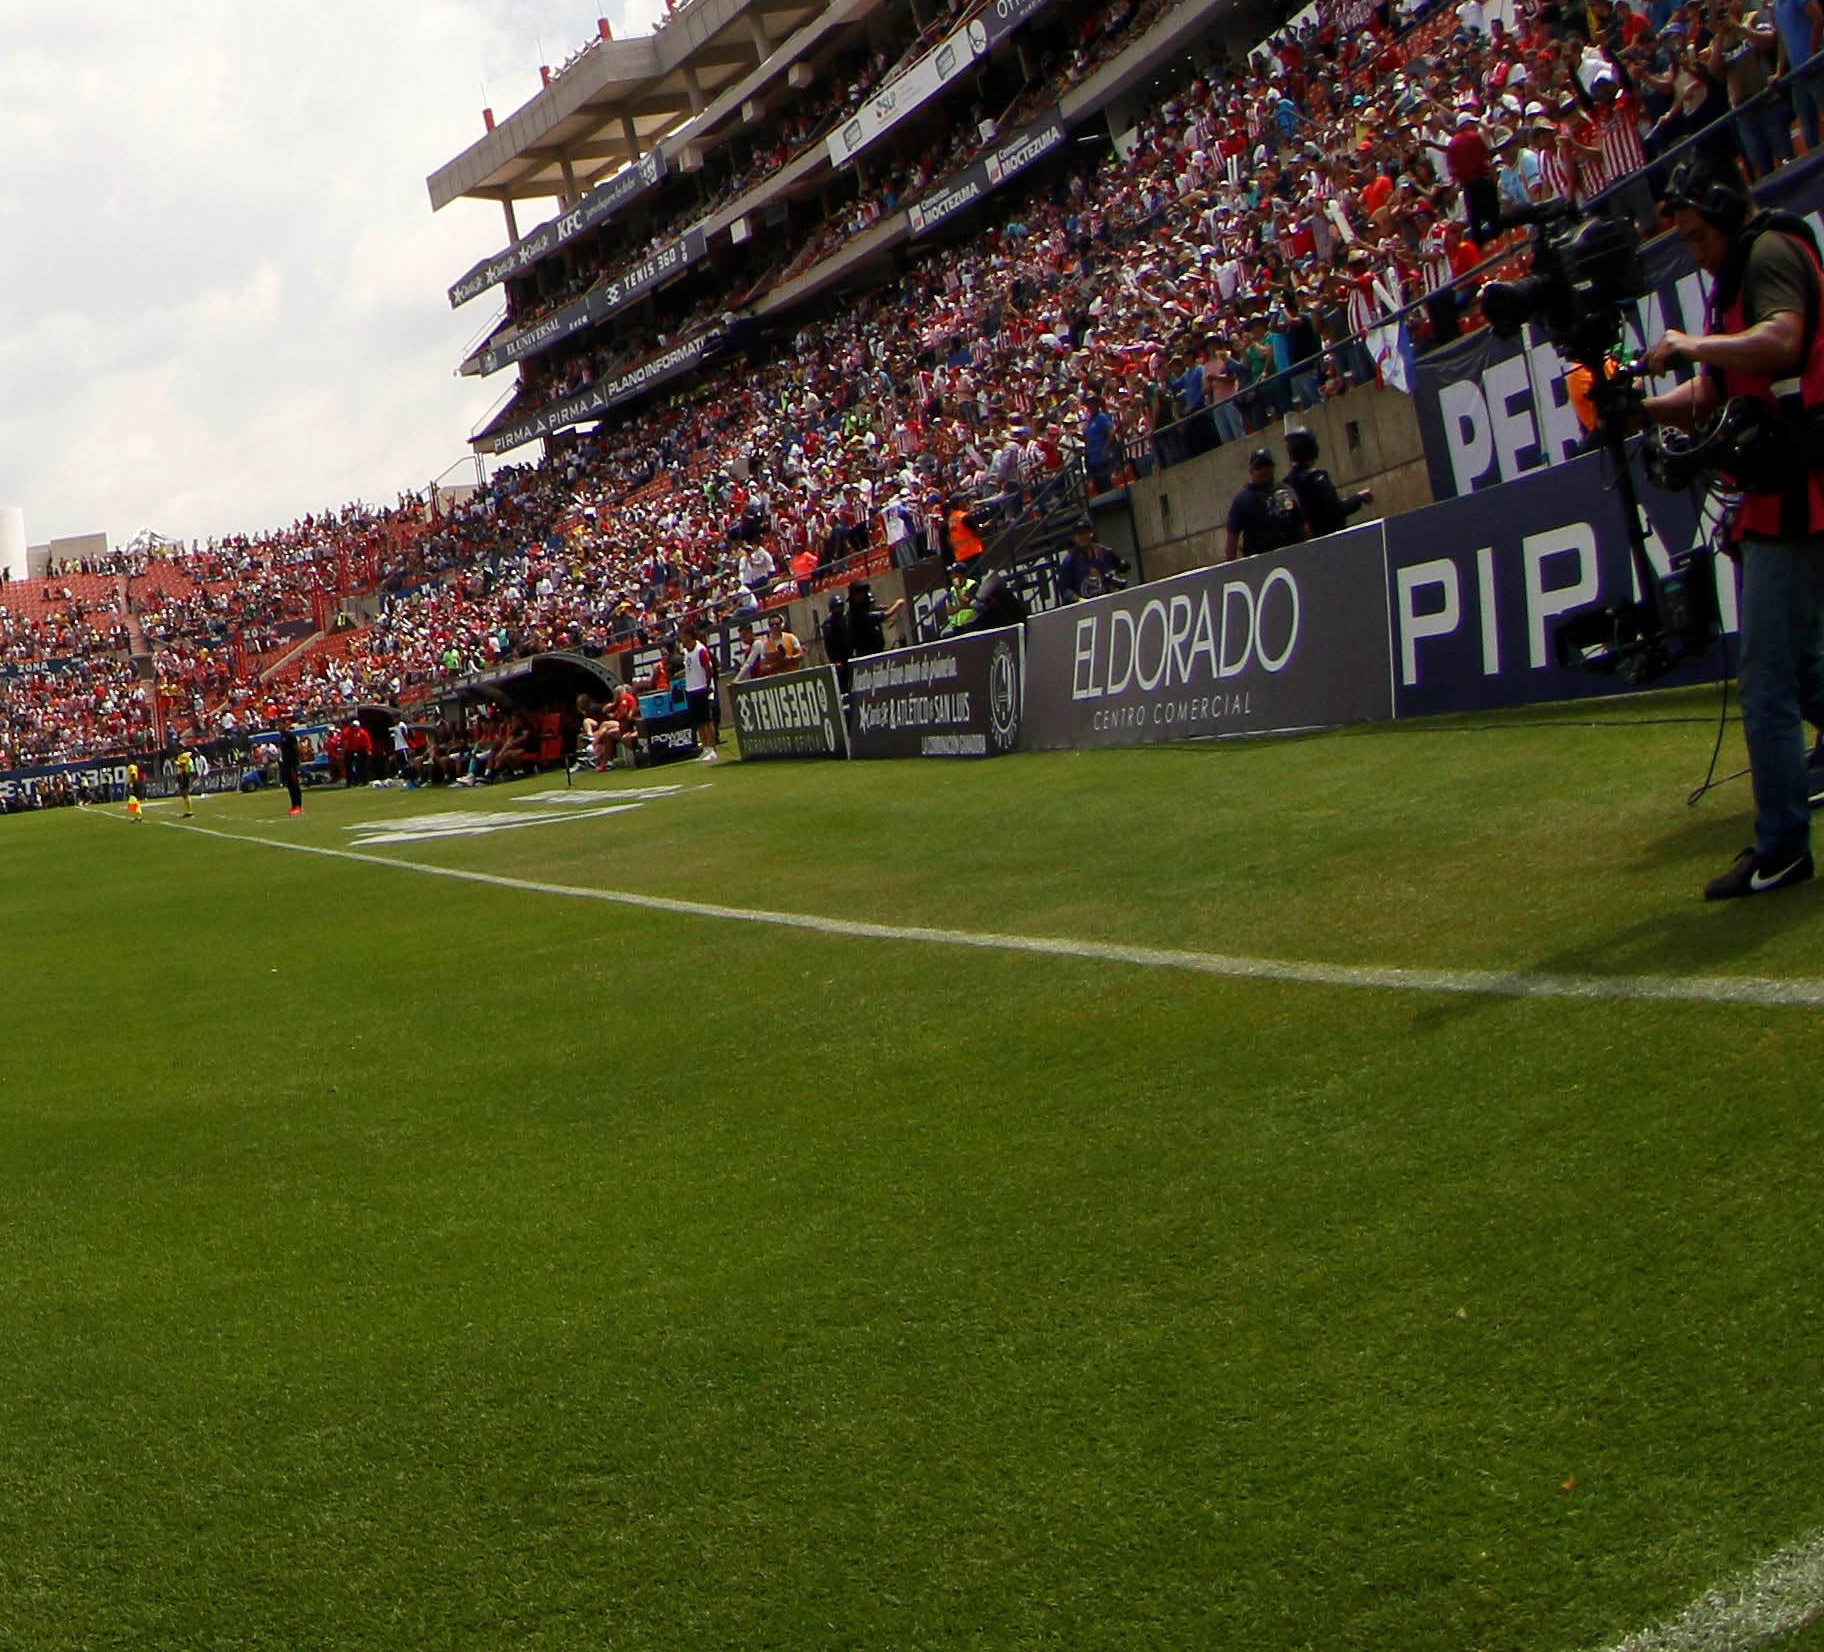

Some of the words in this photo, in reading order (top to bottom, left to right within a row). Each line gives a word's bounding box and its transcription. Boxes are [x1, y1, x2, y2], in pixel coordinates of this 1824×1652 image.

[1000, 125, 1062, 178] MOCTEZUMA
[923, 182, 980, 225] MOCTEZUMA
[555, 209, 584, 243] KFC
[622, 264, 656, 291] TENIS
[657, 250, 677, 271] 360
[515, 318, 561, 353] UNIVERSAL
[606, 369, 645, 397] PLANO
[548, 401, 590, 428] PIRMA
[493, 428, 533, 452] PIRMA
[1072, 616, 1102, 701] EL
[1106, 566, 1300, 696] DORADO
[17, 661, 50, 674] ZONA
[1093, 703, 1146, 732] CENTRO
[1153, 691, 1253, 725] COMERCIAL
